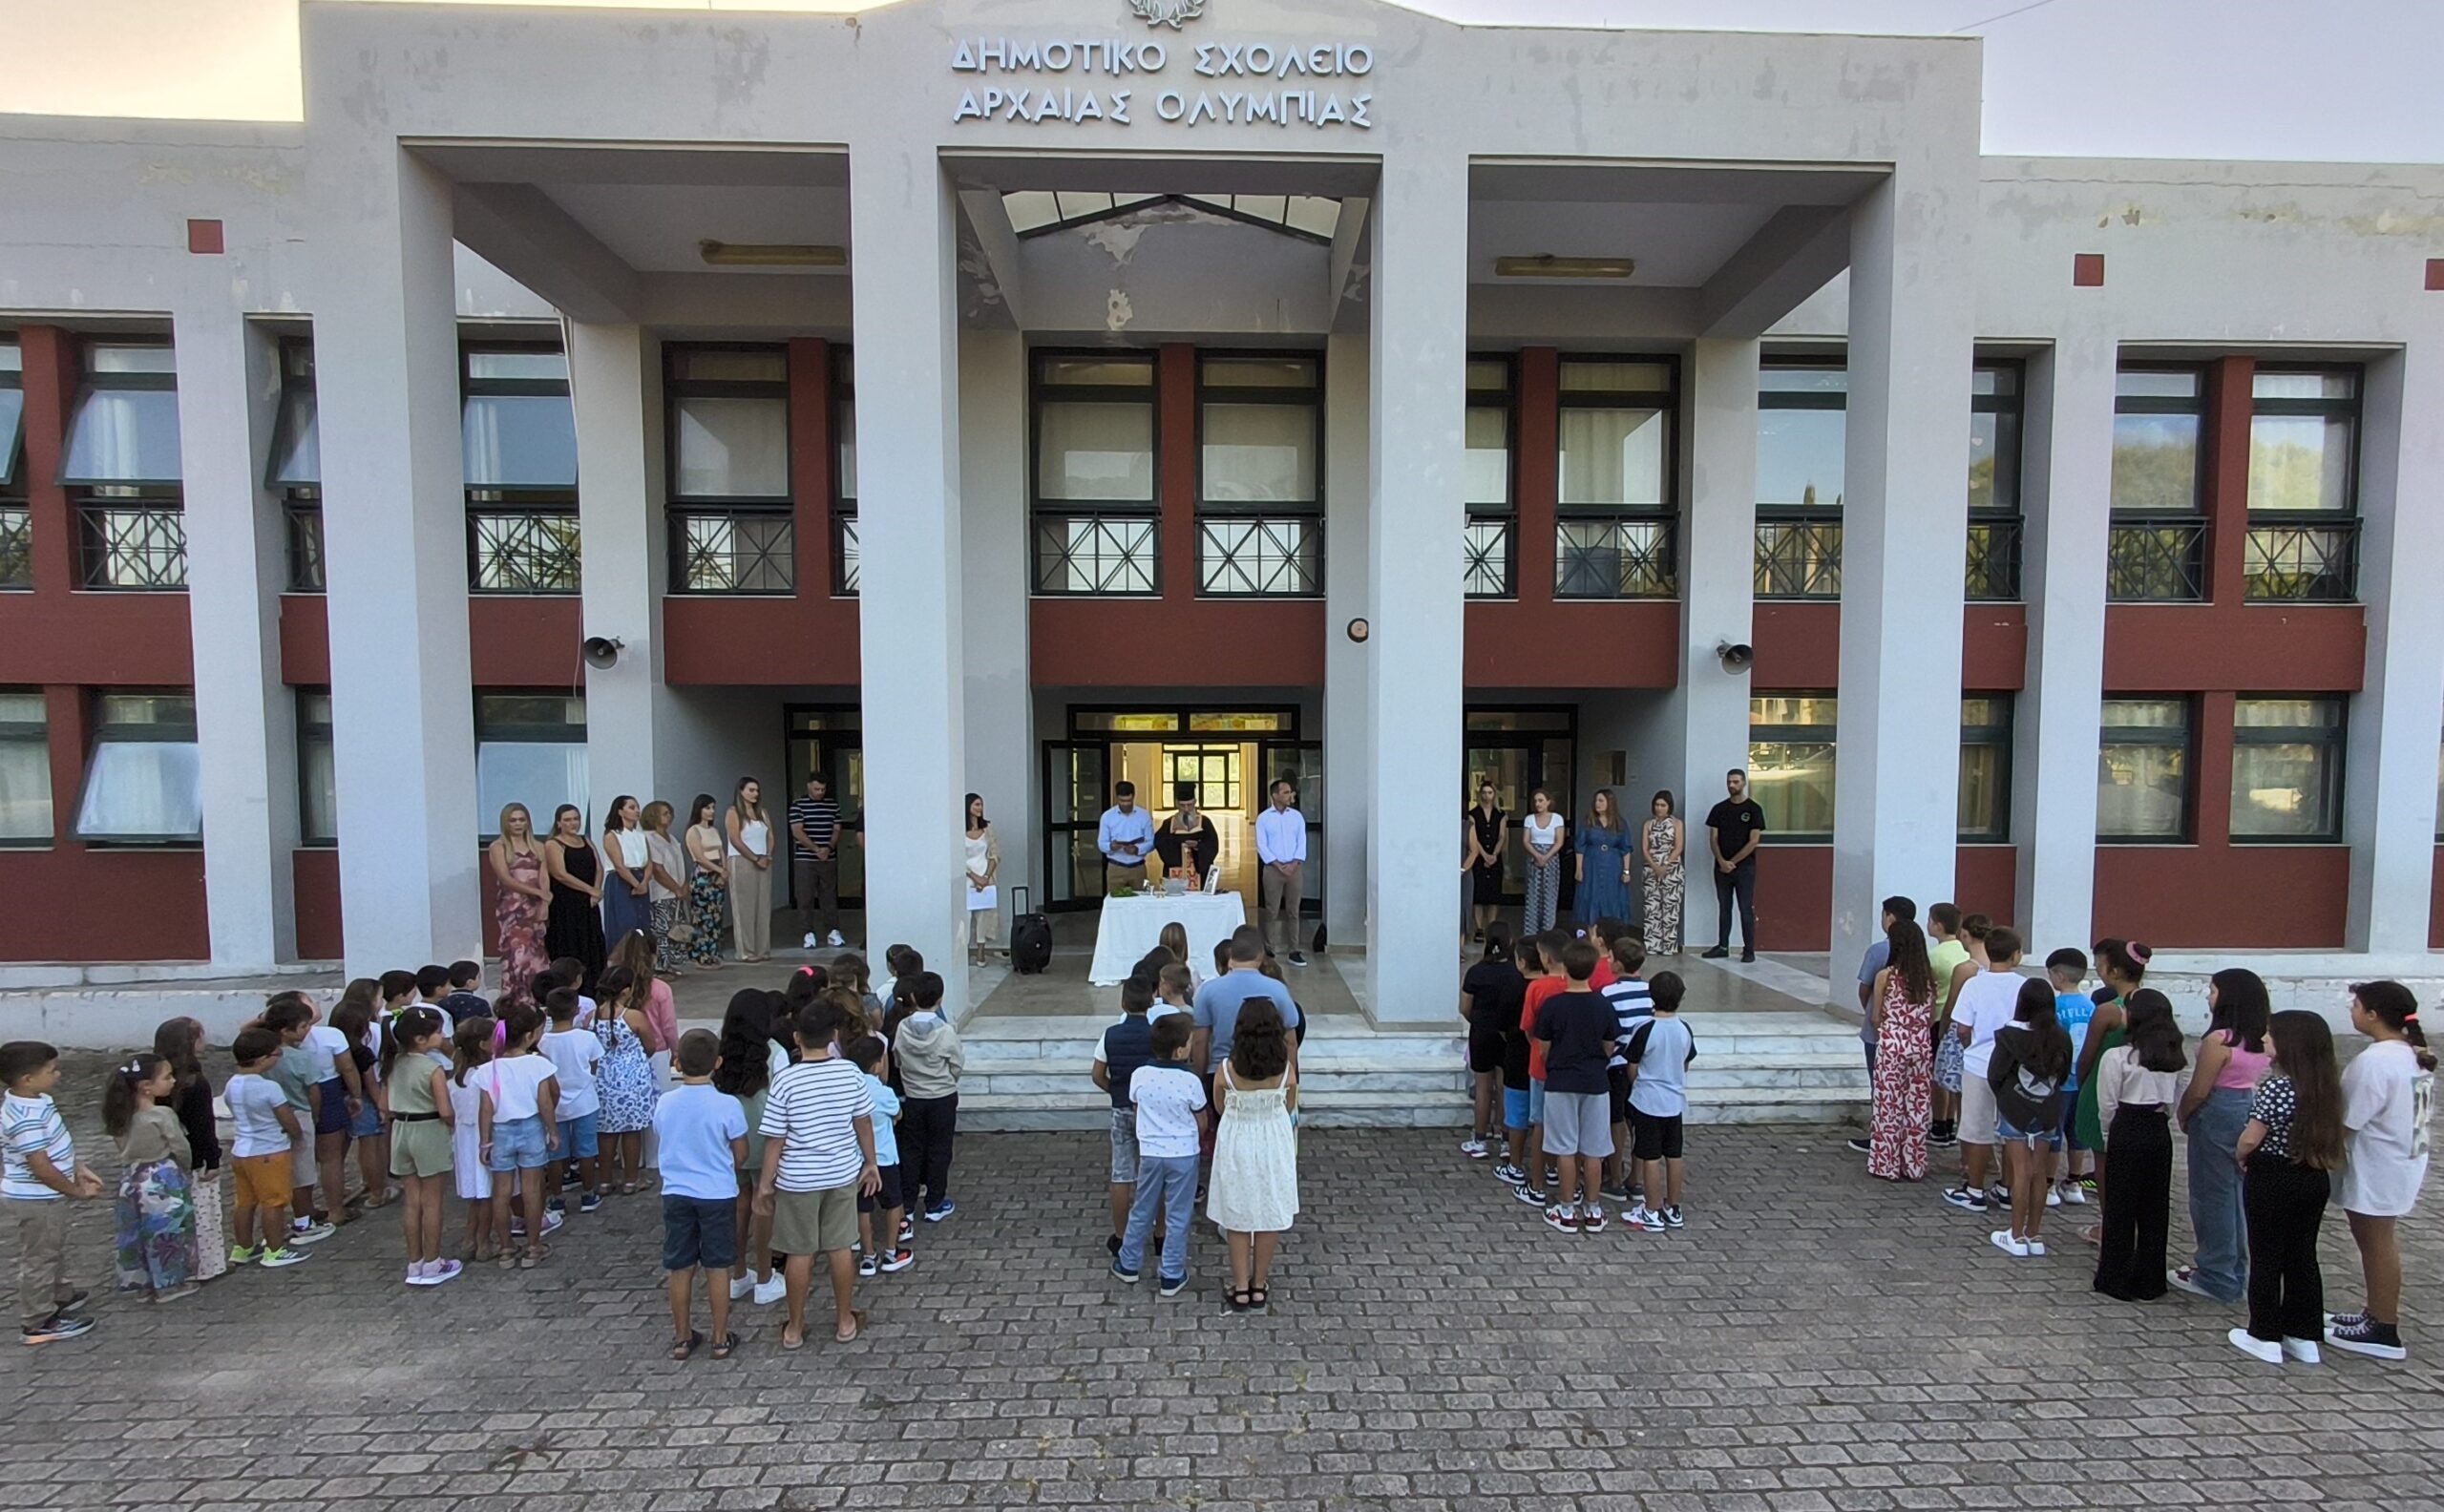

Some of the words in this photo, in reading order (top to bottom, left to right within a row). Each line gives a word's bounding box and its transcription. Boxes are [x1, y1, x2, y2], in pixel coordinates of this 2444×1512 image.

[952, 36, 1167, 76] ΔΗΜΟΤΙΚΟ
[1193, 41, 1374, 79] ΣΧΟΛΕΙΟ
[953, 87, 1131, 125] ΑΡΧΑΙΑΣ
[1155, 89, 1373, 128] ΟΛΥΜΠΙΑΣ
